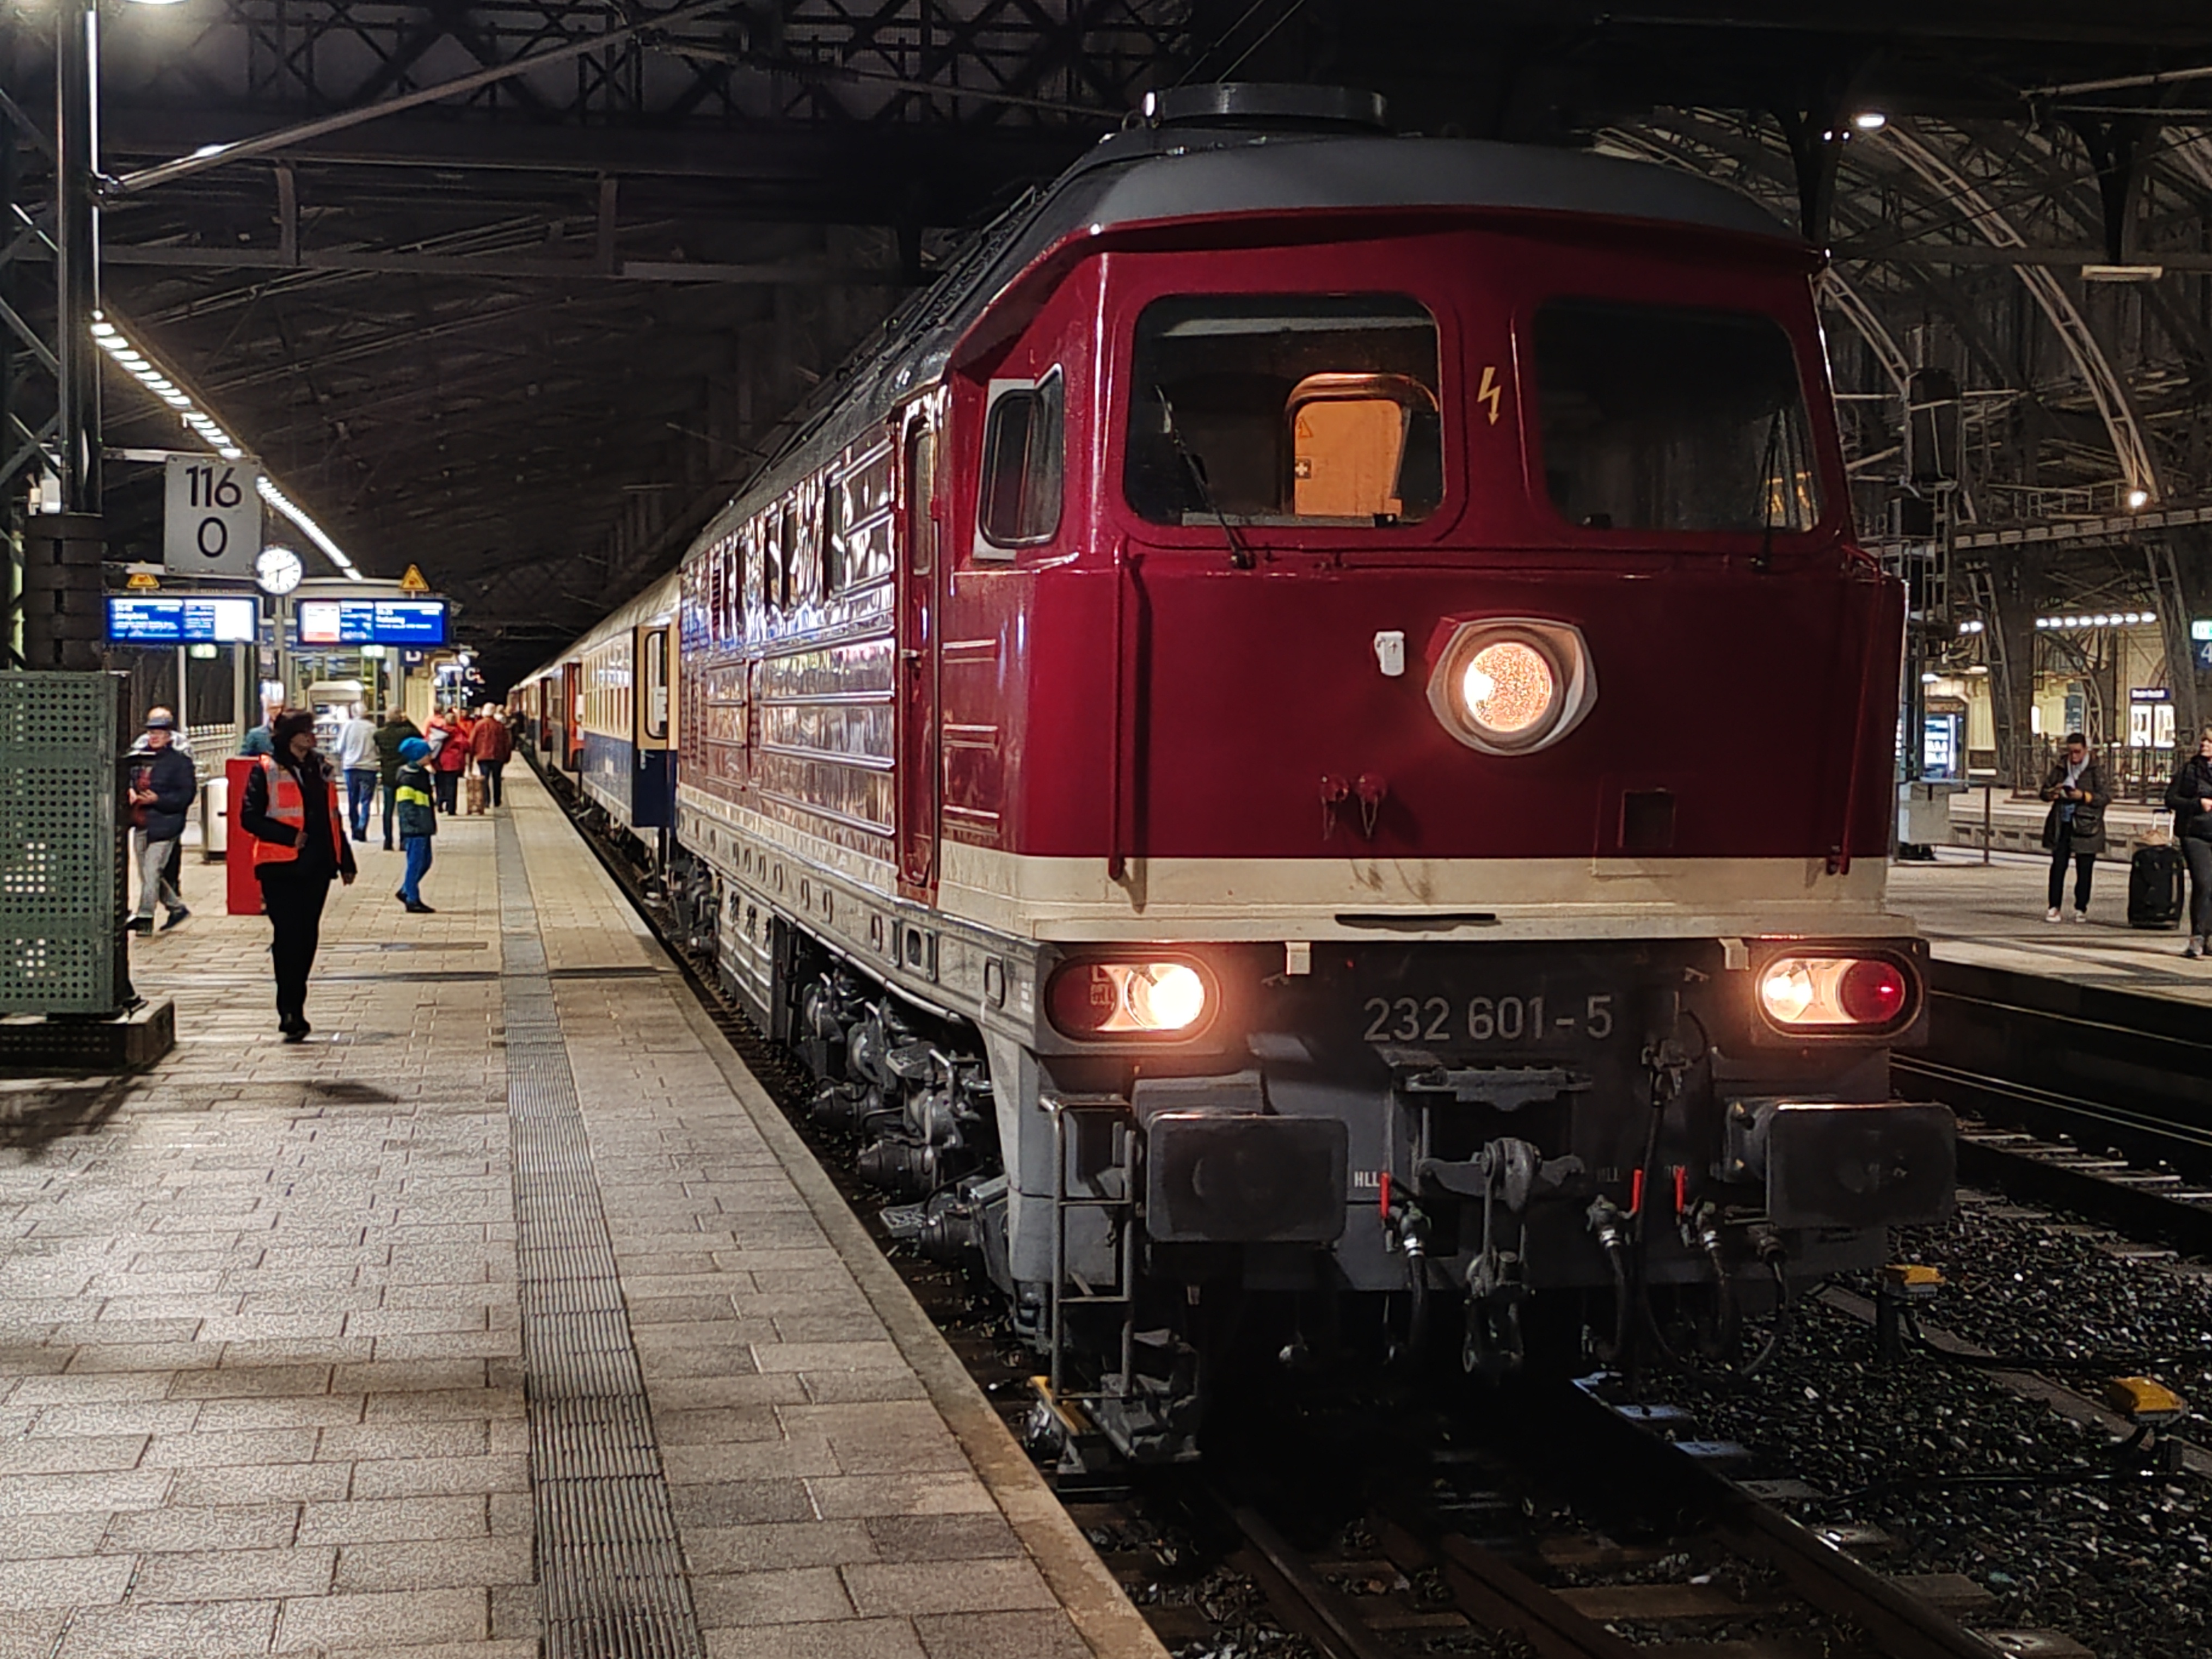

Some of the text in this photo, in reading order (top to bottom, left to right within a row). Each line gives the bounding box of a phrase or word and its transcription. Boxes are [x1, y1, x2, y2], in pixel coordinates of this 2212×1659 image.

[186, 465, 242, 508] 116
[197, 516, 228, 558] 0
[1363, 997, 1451, 1041] 232
